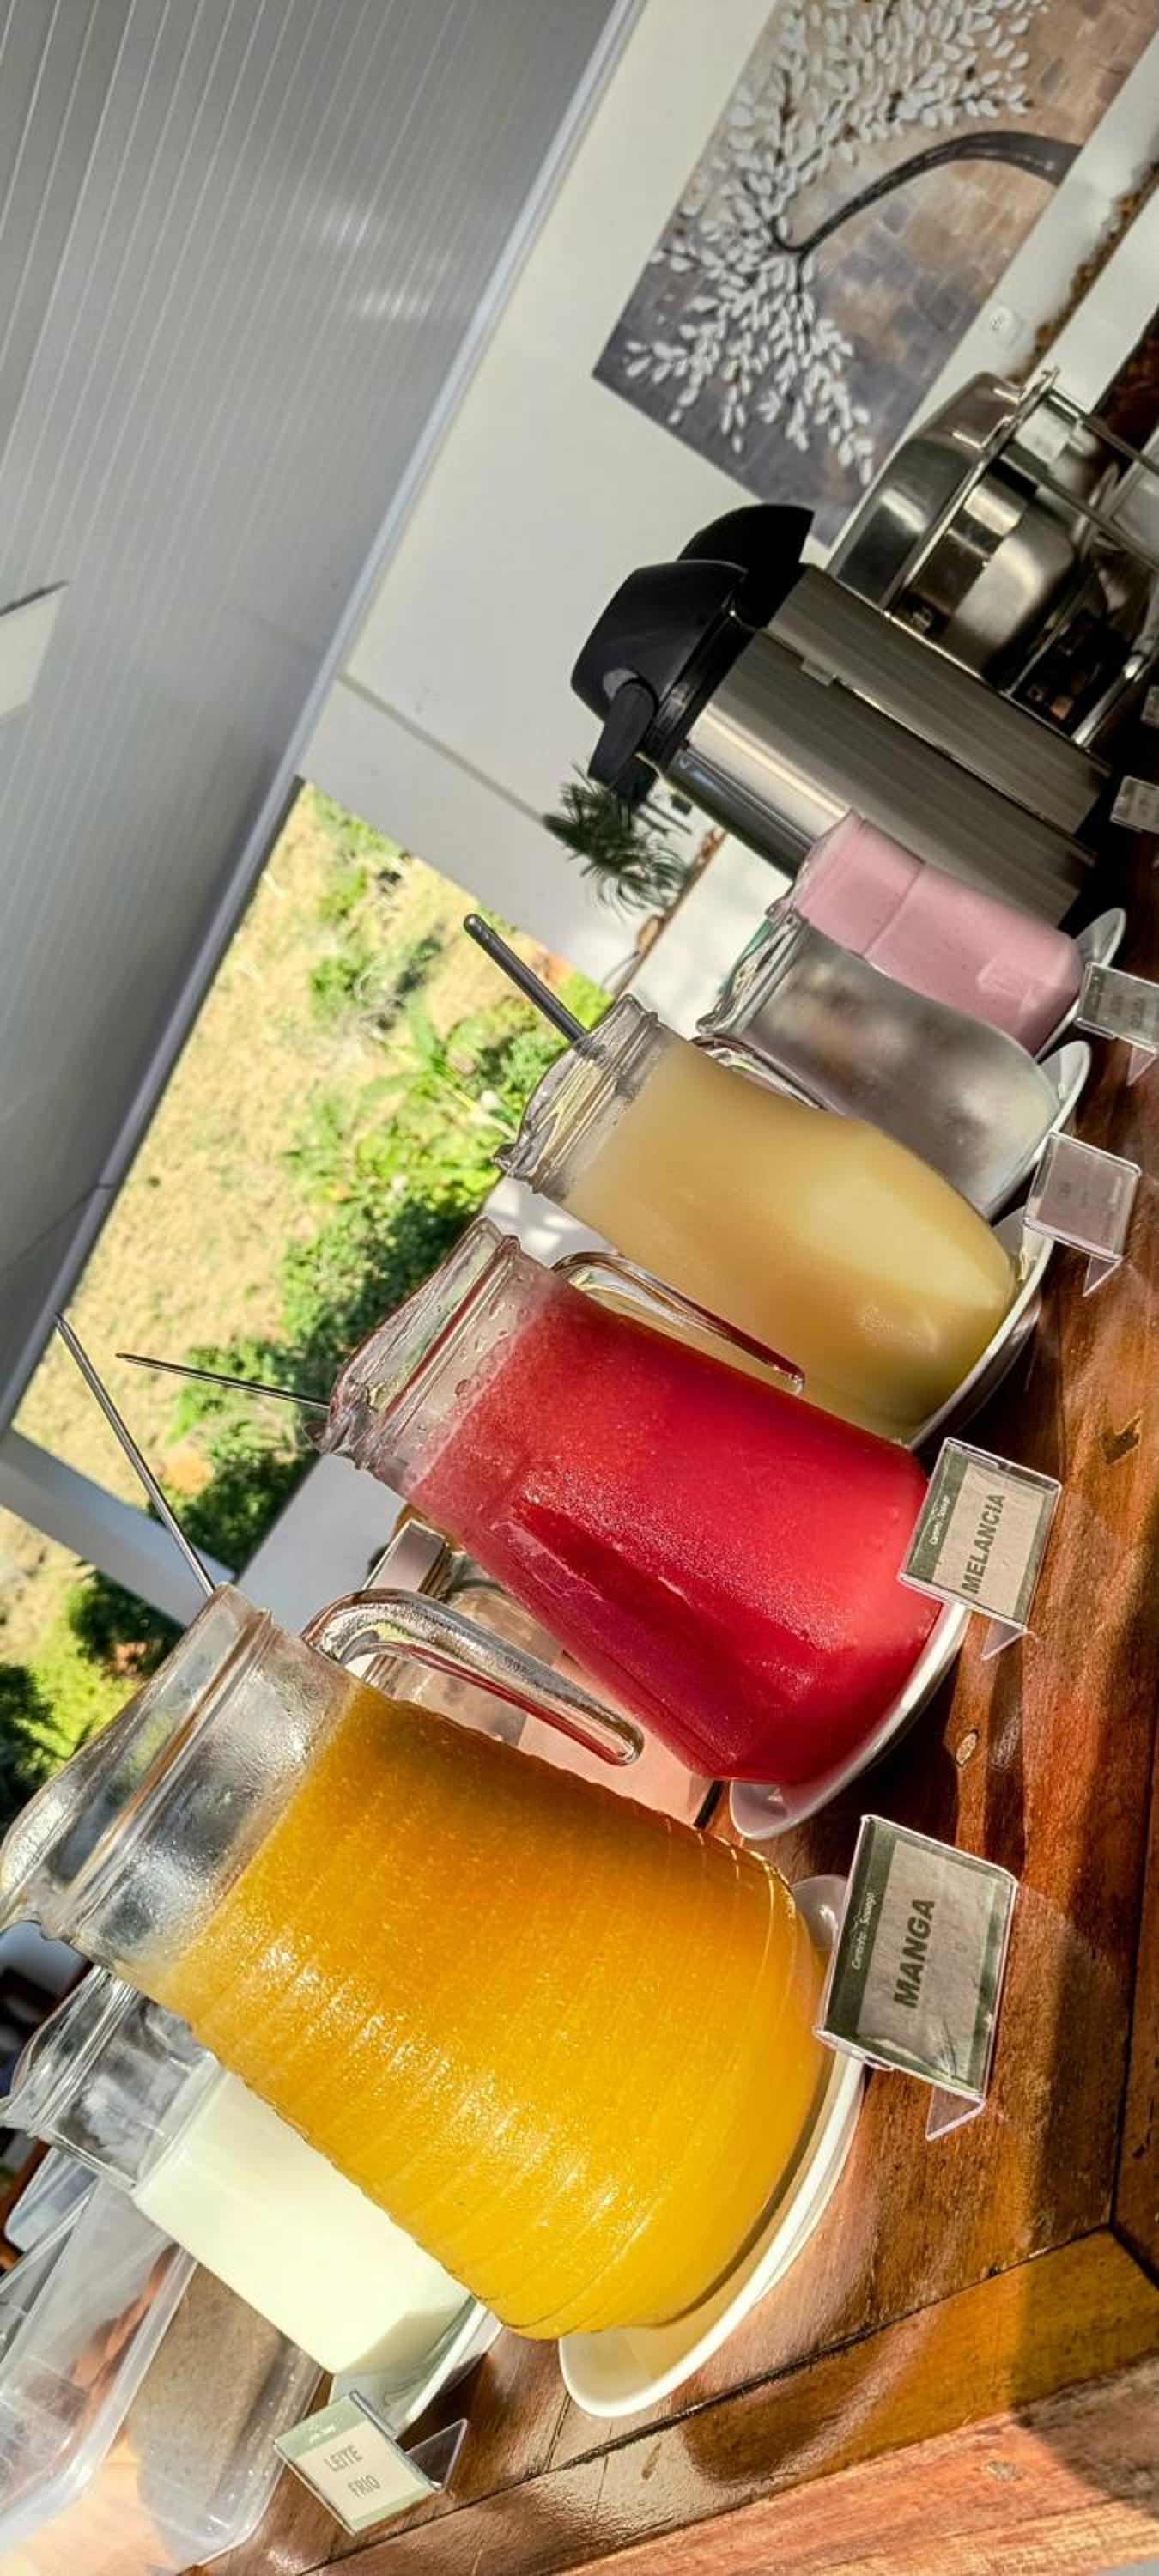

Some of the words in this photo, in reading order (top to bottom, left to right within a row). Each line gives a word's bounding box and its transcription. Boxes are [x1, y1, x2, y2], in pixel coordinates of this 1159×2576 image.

[961, 1493, 1006, 1595] MELANCIA
[893, 1899, 935, 2008] MANGA
[323, 2445, 363, 2472] LEITE
